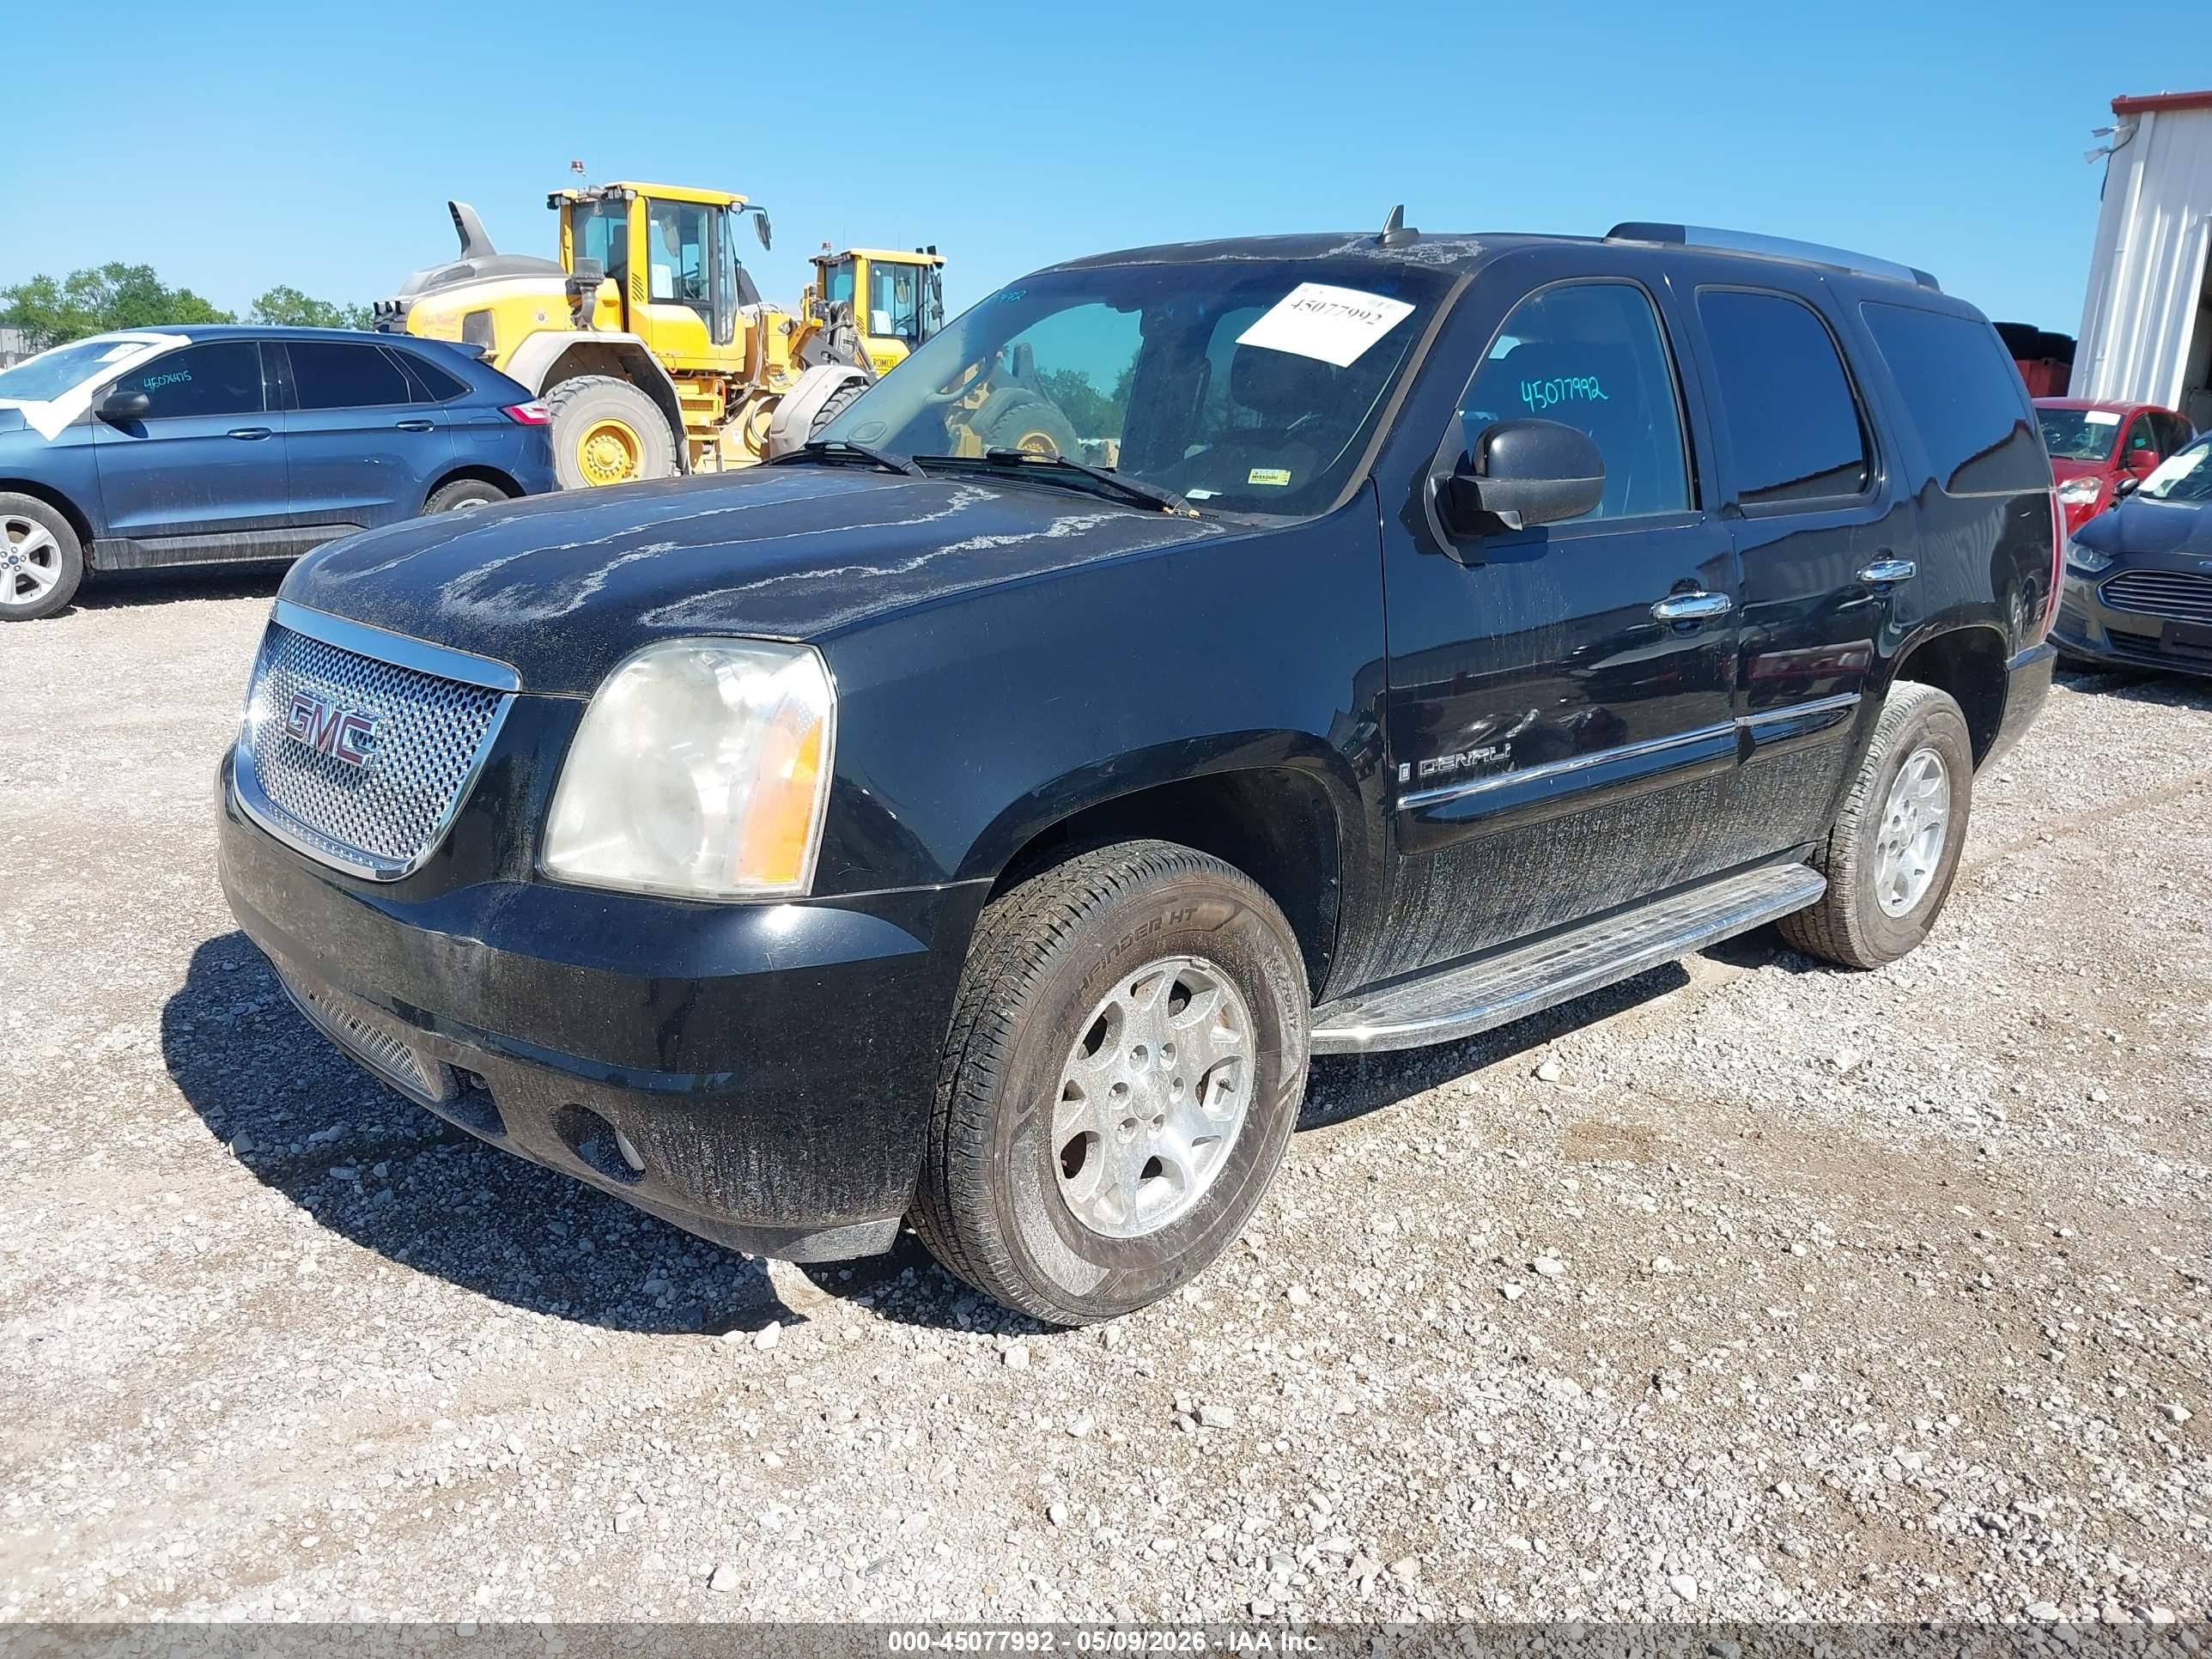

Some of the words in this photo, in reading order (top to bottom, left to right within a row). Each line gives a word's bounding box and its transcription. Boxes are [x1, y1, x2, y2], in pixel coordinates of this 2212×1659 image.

[1291, 299, 1383, 325] 45077992
[1521, 376, 1608, 413] 45077992
[285, 692, 378, 770] GMC
[1418, 743, 1512, 776] DENALI
[1169, 906, 1198, 926] HT
